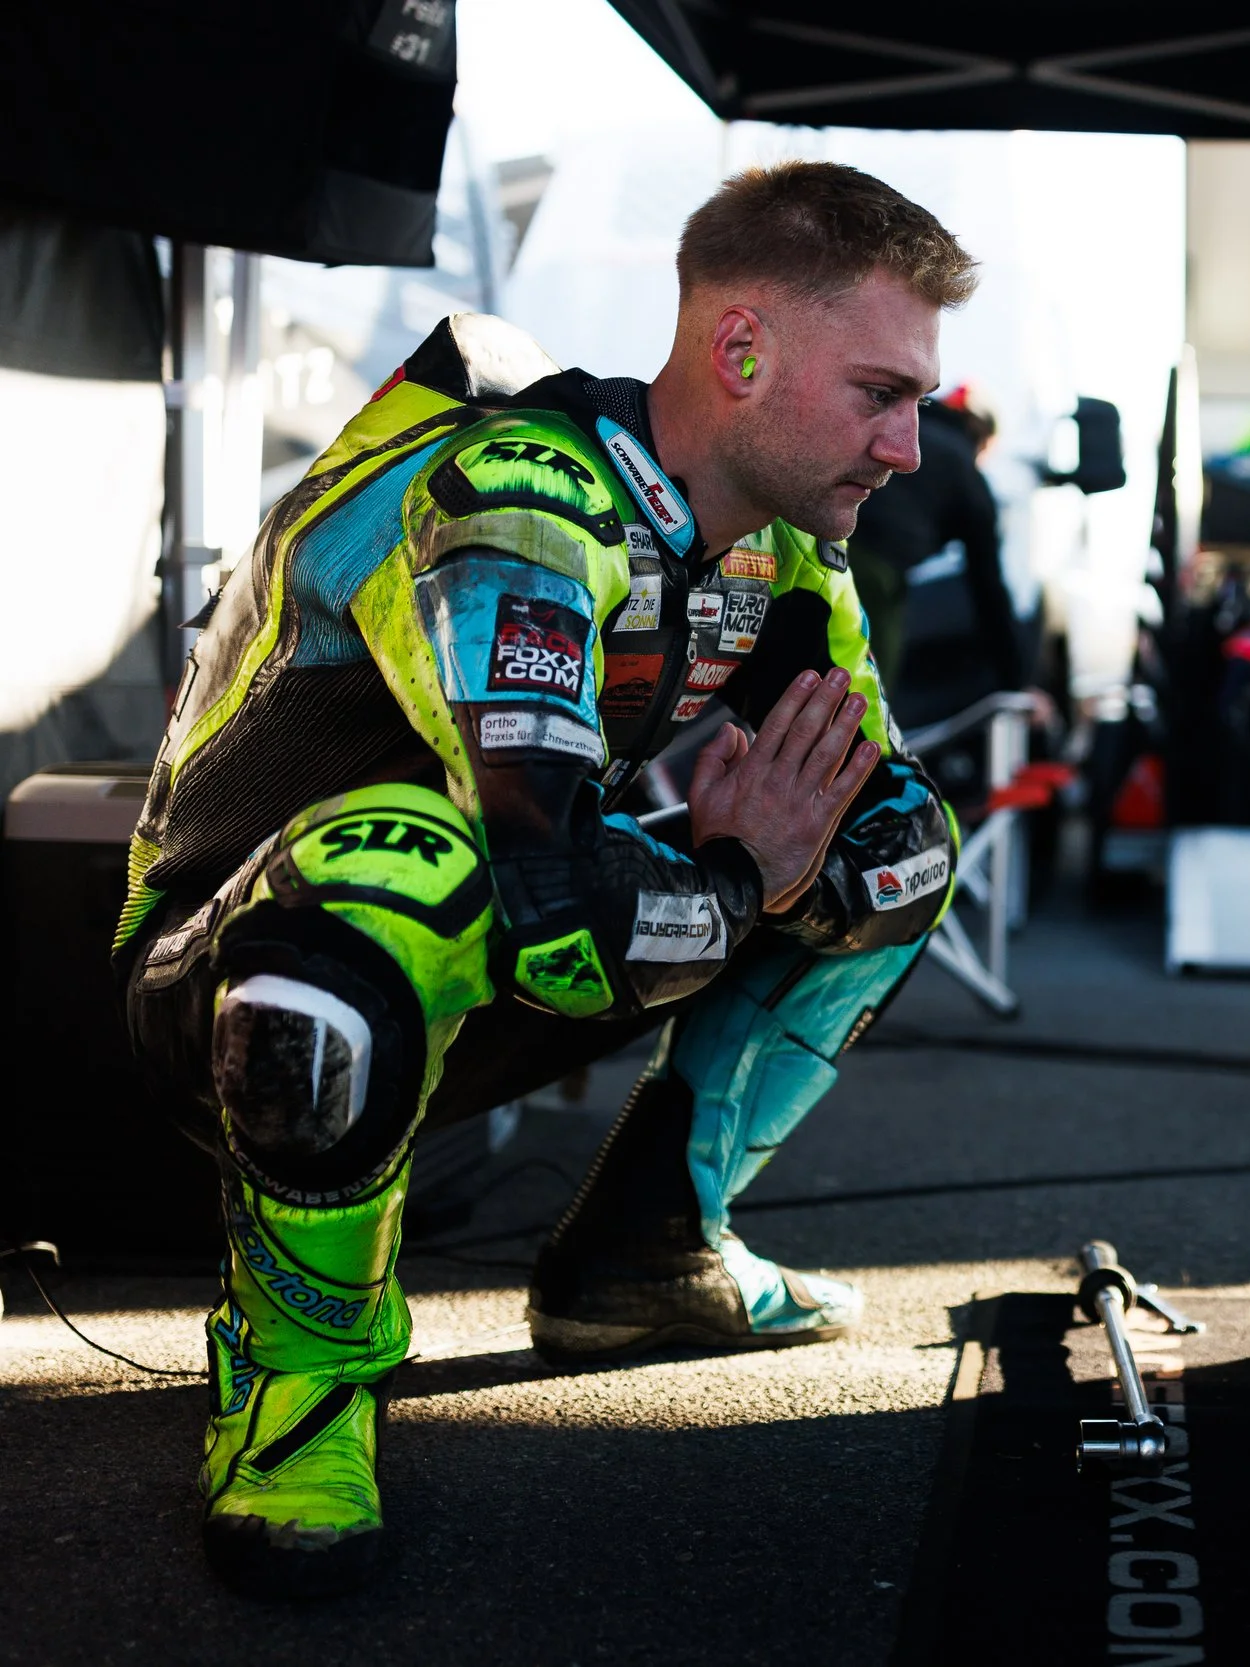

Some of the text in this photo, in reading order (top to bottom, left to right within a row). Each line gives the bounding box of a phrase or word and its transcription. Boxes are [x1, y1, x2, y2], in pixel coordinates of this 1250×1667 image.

[481, 441, 595, 490] SLR
[643, 599, 656, 611] DIE
[727, 594, 765, 616] EURO
[723, 613, 762, 635] MOTO
[497, 645, 581, 677] FOXX
[495, 661, 580, 692] .COM
[688, 662, 735, 686] MOTU
[485, 717, 517, 729] ortho
[484, 732, 514, 743] Praxis
[517, 730, 531, 741] für
[320, 819, 453, 867] SLR
[904, 857, 946, 896] repairoo
